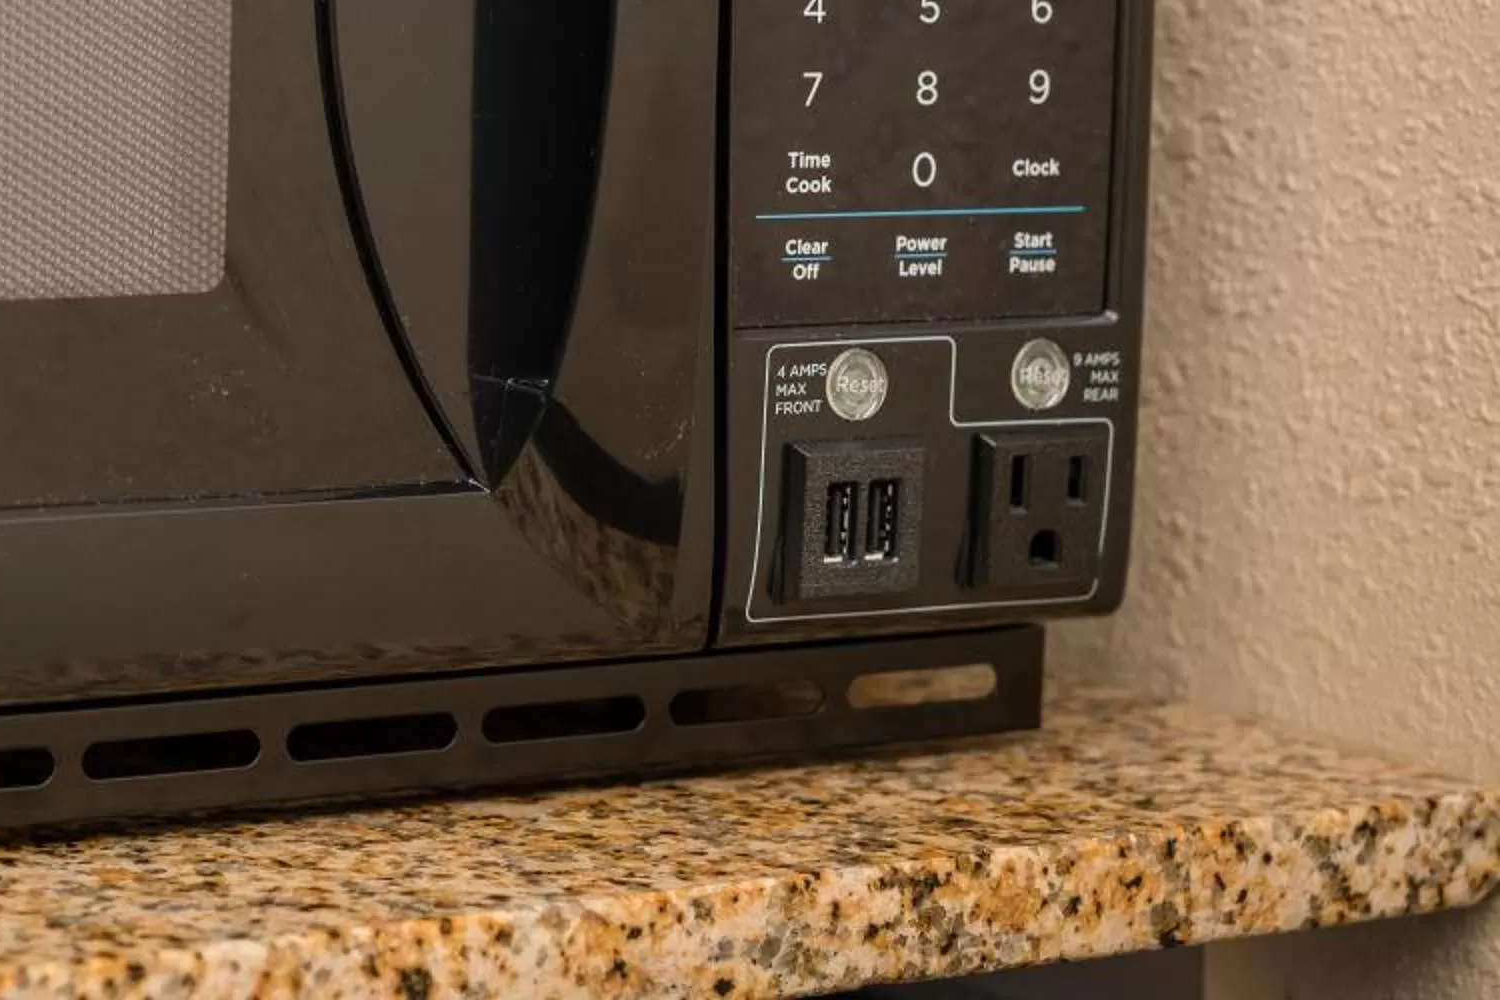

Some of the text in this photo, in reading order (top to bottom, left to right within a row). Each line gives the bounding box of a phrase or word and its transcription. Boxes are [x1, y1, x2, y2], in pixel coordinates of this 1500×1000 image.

[803, 72, 823, 107] 7
[916, 70, 938, 105] 8
[1029, 69, 1050, 104] 9
[788, 152, 831, 169] Time
[1012, 158, 1060, 177] Clock
[912, 152, 936, 187] 0
[786, 176, 831, 194] Cook
[785, 239, 829, 256] Clear
[896, 236, 947, 252] Power
[1013, 232, 1053, 248] Start
[793, 264, 820, 280] Off
[899, 259, 943, 276] Level
[1009, 257, 1055, 273] Pause
[1084, 352, 1120, 367] AMPS
[776, 363, 828, 378] 4 AMPS
[1090, 370, 1119, 383] MAX
[775, 382, 807, 397] MAX
[836, 375, 885, 393] Reset
[775, 400, 822, 415] FRONT
